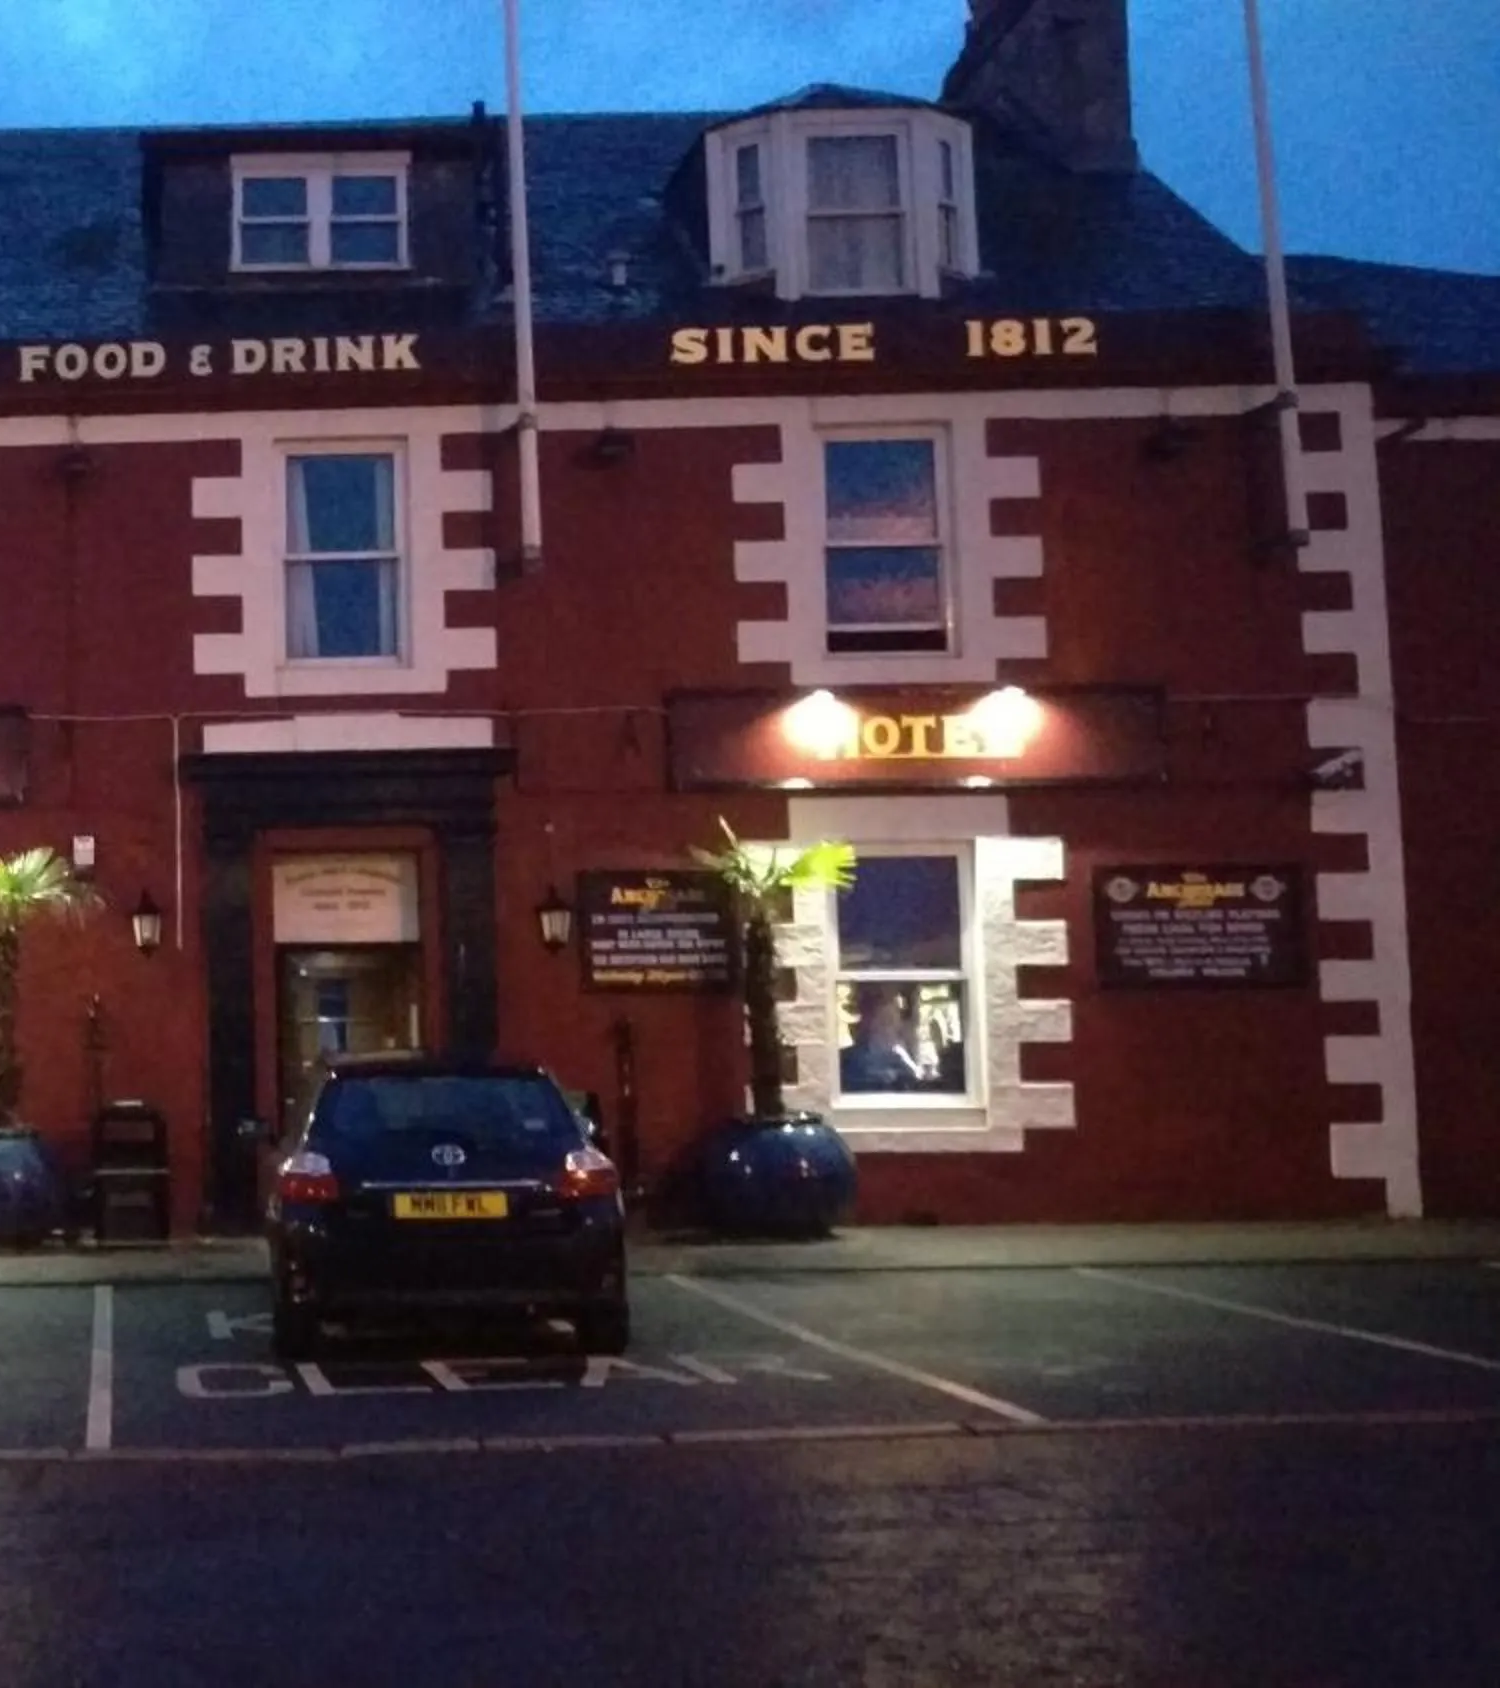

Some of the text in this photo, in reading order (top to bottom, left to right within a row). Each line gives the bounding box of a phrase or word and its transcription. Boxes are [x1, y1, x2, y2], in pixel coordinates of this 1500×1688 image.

[18, 341, 167, 382] FOOD
[189, 344, 213, 377] &
[230, 333, 422, 375] DRINK
[669, 317, 1098, 364] SINCE 1812
